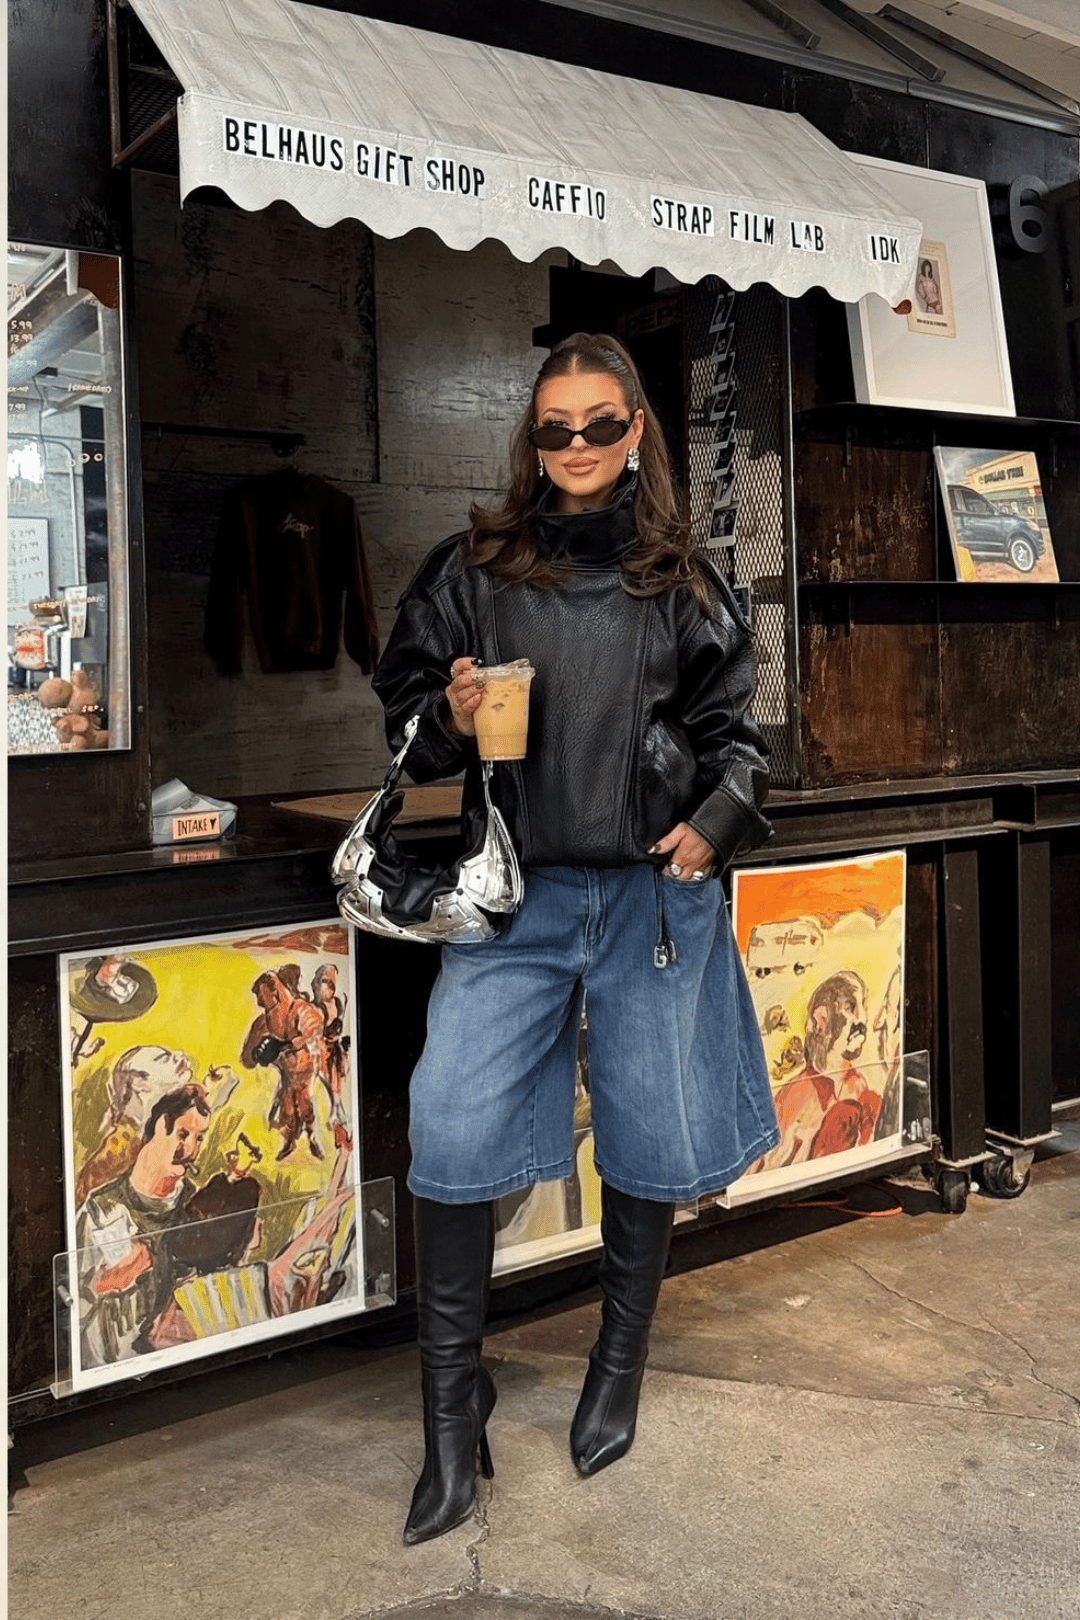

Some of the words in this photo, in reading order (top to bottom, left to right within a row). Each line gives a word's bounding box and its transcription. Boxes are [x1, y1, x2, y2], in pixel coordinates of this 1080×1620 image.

[225, 118, 344, 171] BELHAUS
[356, 144, 413, 186] GIFT
[426, 160, 485, 197] SHOP
[528, 177, 606, 221] CAFFIO
[1009, 174, 1048, 254] 6
[652, 199, 712, 235] STRAP
[729, 211, 774, 245] FILM
[790, 222, 824, 251] LAB
[870, 235, 900, 263] IDK
[177, 818, 208, 836] INTAKE
